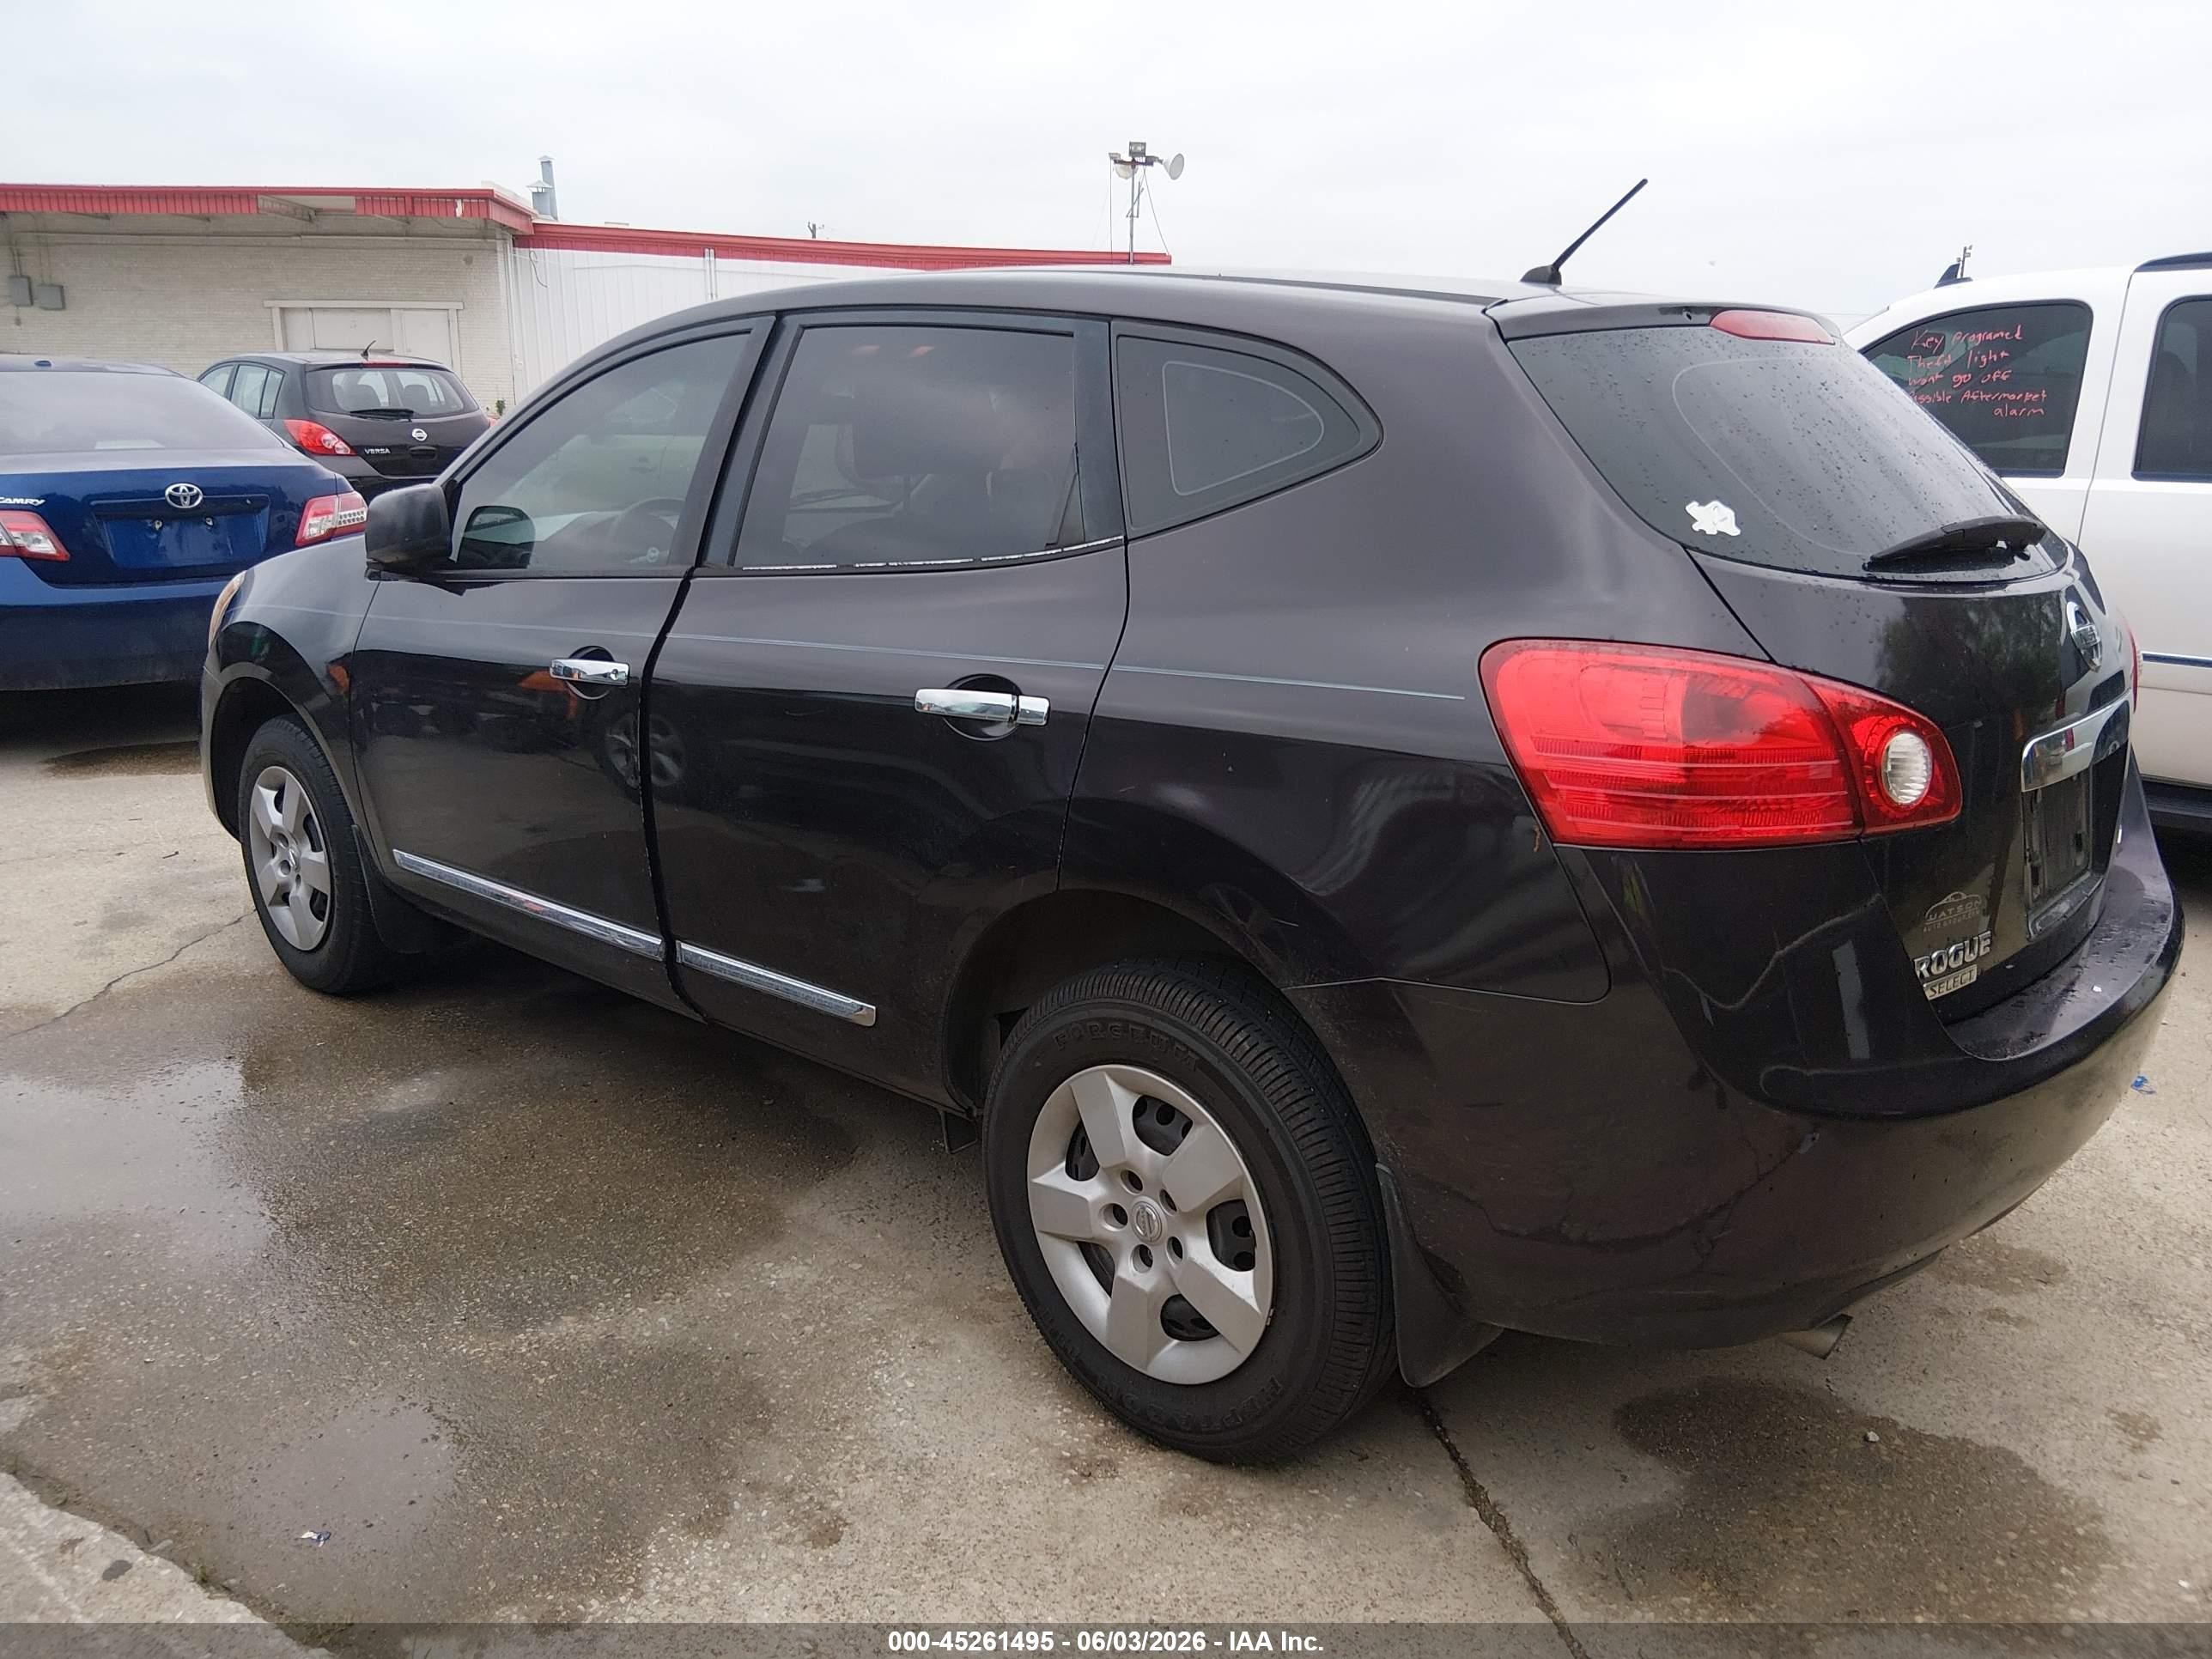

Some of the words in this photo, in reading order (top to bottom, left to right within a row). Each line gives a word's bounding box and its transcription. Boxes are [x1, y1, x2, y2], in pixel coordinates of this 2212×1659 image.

[1911, 329, 1944, 354] Key
[1952, 374, 1972, 388] go
[1993, 404, 2045, 418] alarm
[364, 447, 392, 455] VERSA
[1913, 930, 1992, 979] ROGUE
[1929, 969, 1974, 998] SELECT
